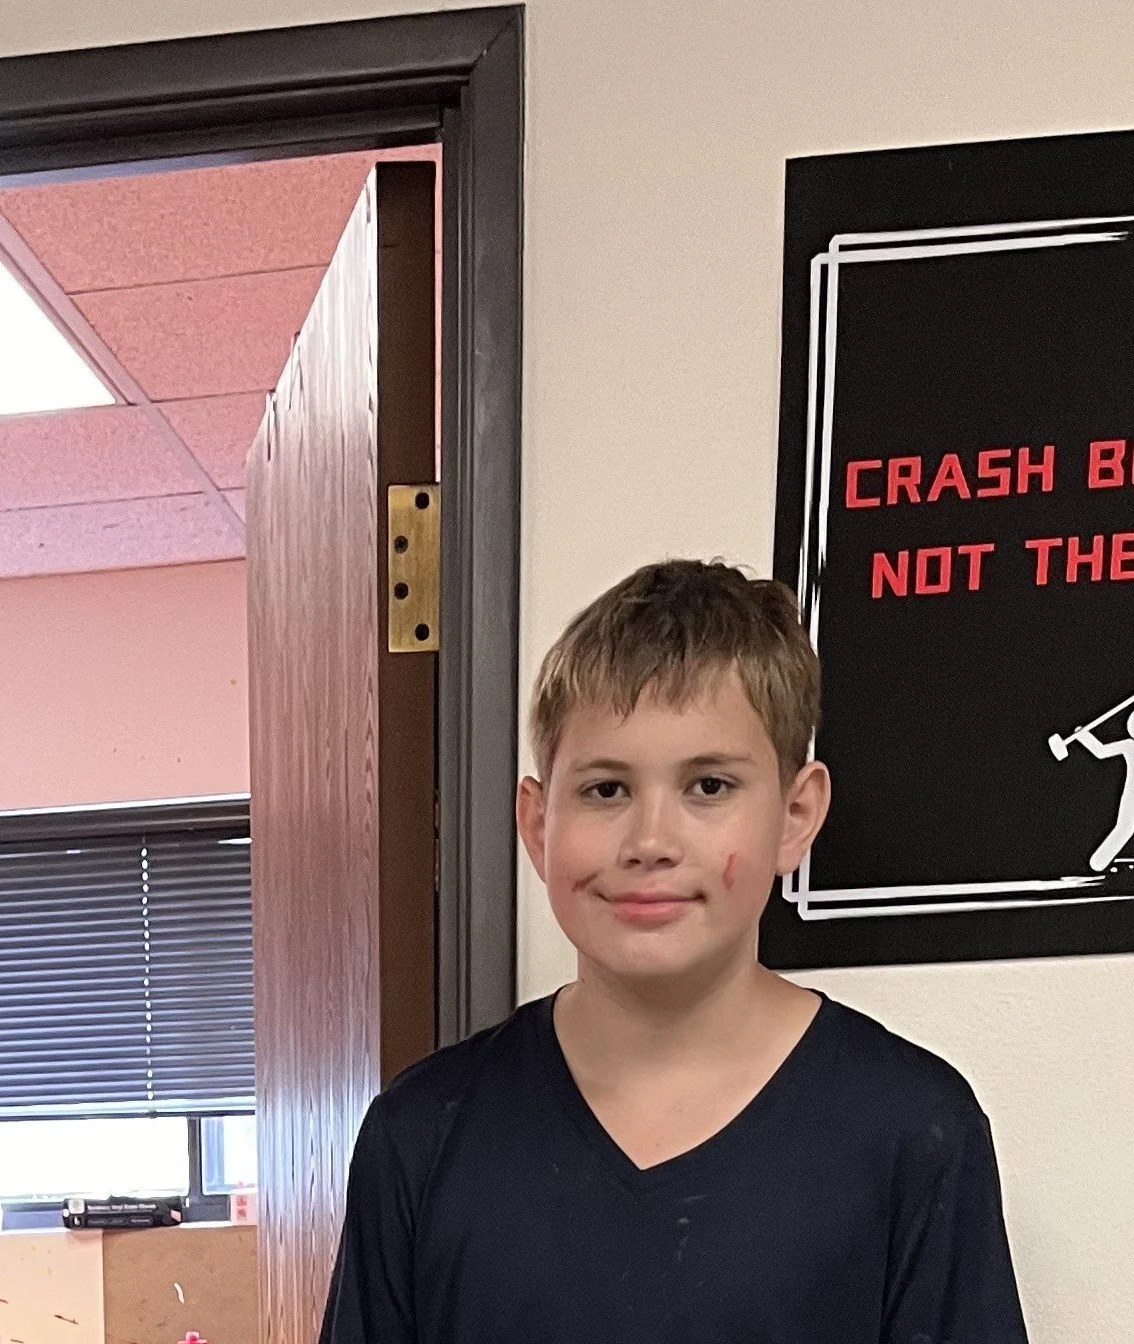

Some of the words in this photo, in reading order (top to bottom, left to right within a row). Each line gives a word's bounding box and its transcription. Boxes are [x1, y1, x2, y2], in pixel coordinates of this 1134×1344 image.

[846, 446, 1055, 508] CRASH
[1088, 440, 1134, 489] B
[872, 544, 995, 598] NOT
[1025, 533, 1134, 586] THE
